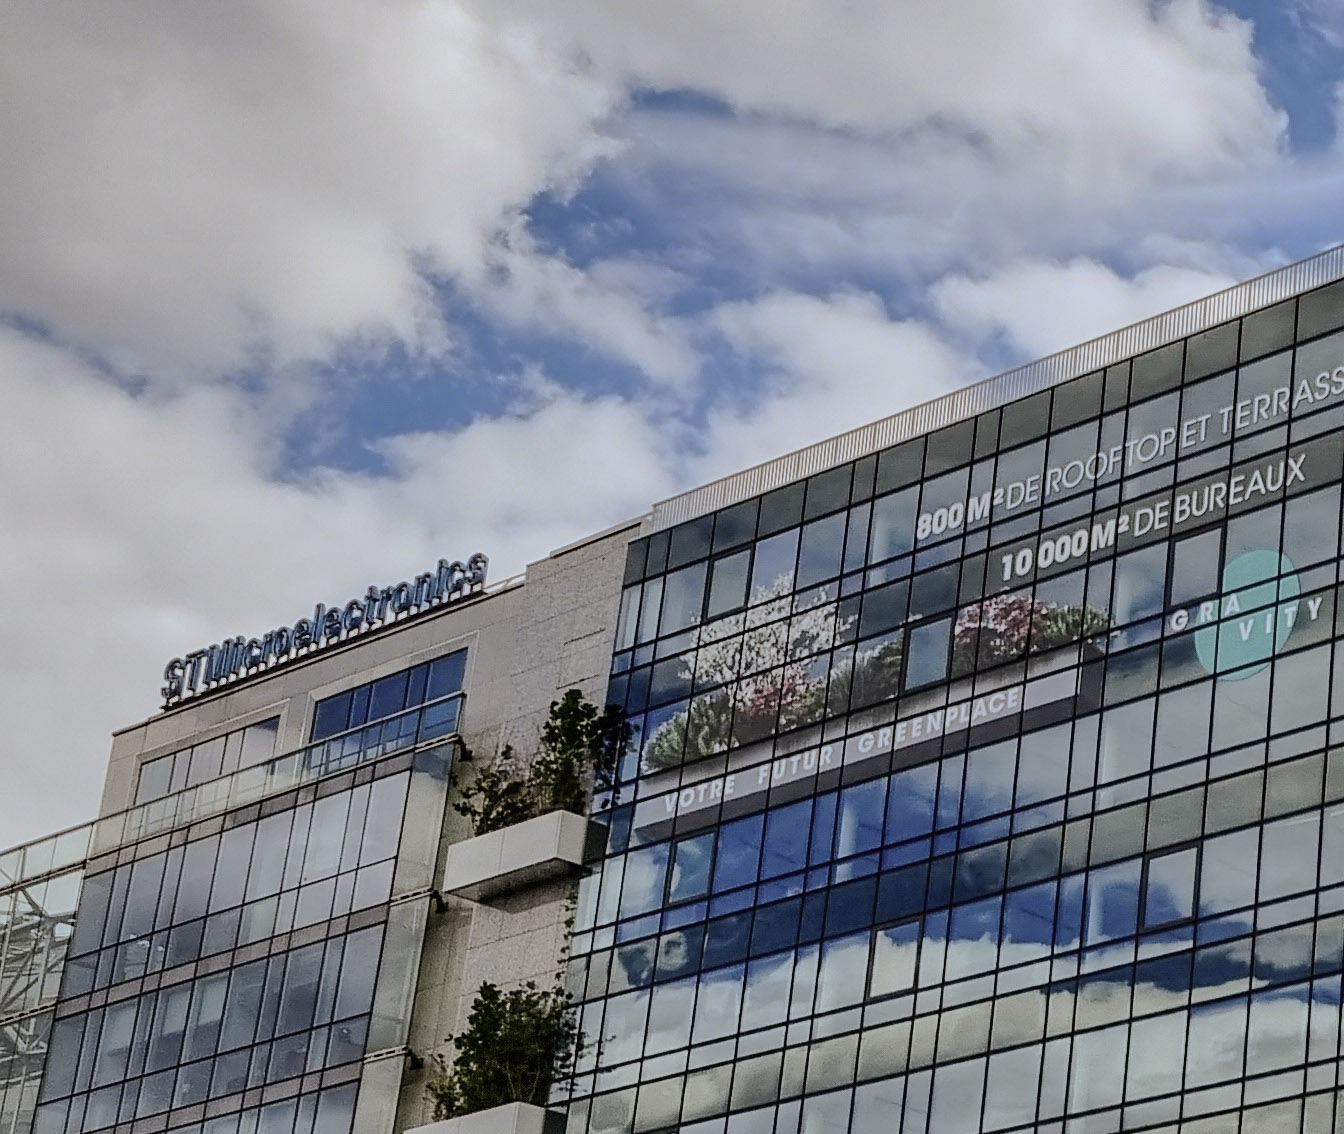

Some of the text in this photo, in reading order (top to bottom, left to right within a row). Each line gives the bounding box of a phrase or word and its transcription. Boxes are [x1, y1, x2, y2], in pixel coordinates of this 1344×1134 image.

[915, 502, 964, 541] 800
[1006, 473, 1041, 512] DE
[1044, 426, 1178, 498] ROOFTOP
[1180, 413, 1214, 450] ET
[1133, 499, 1170, 538] DE
[1173, 453, 1308, 525] BUREAUX
[663, 686, 1021, 815] VOTRE FUTUR GREENPLACE
